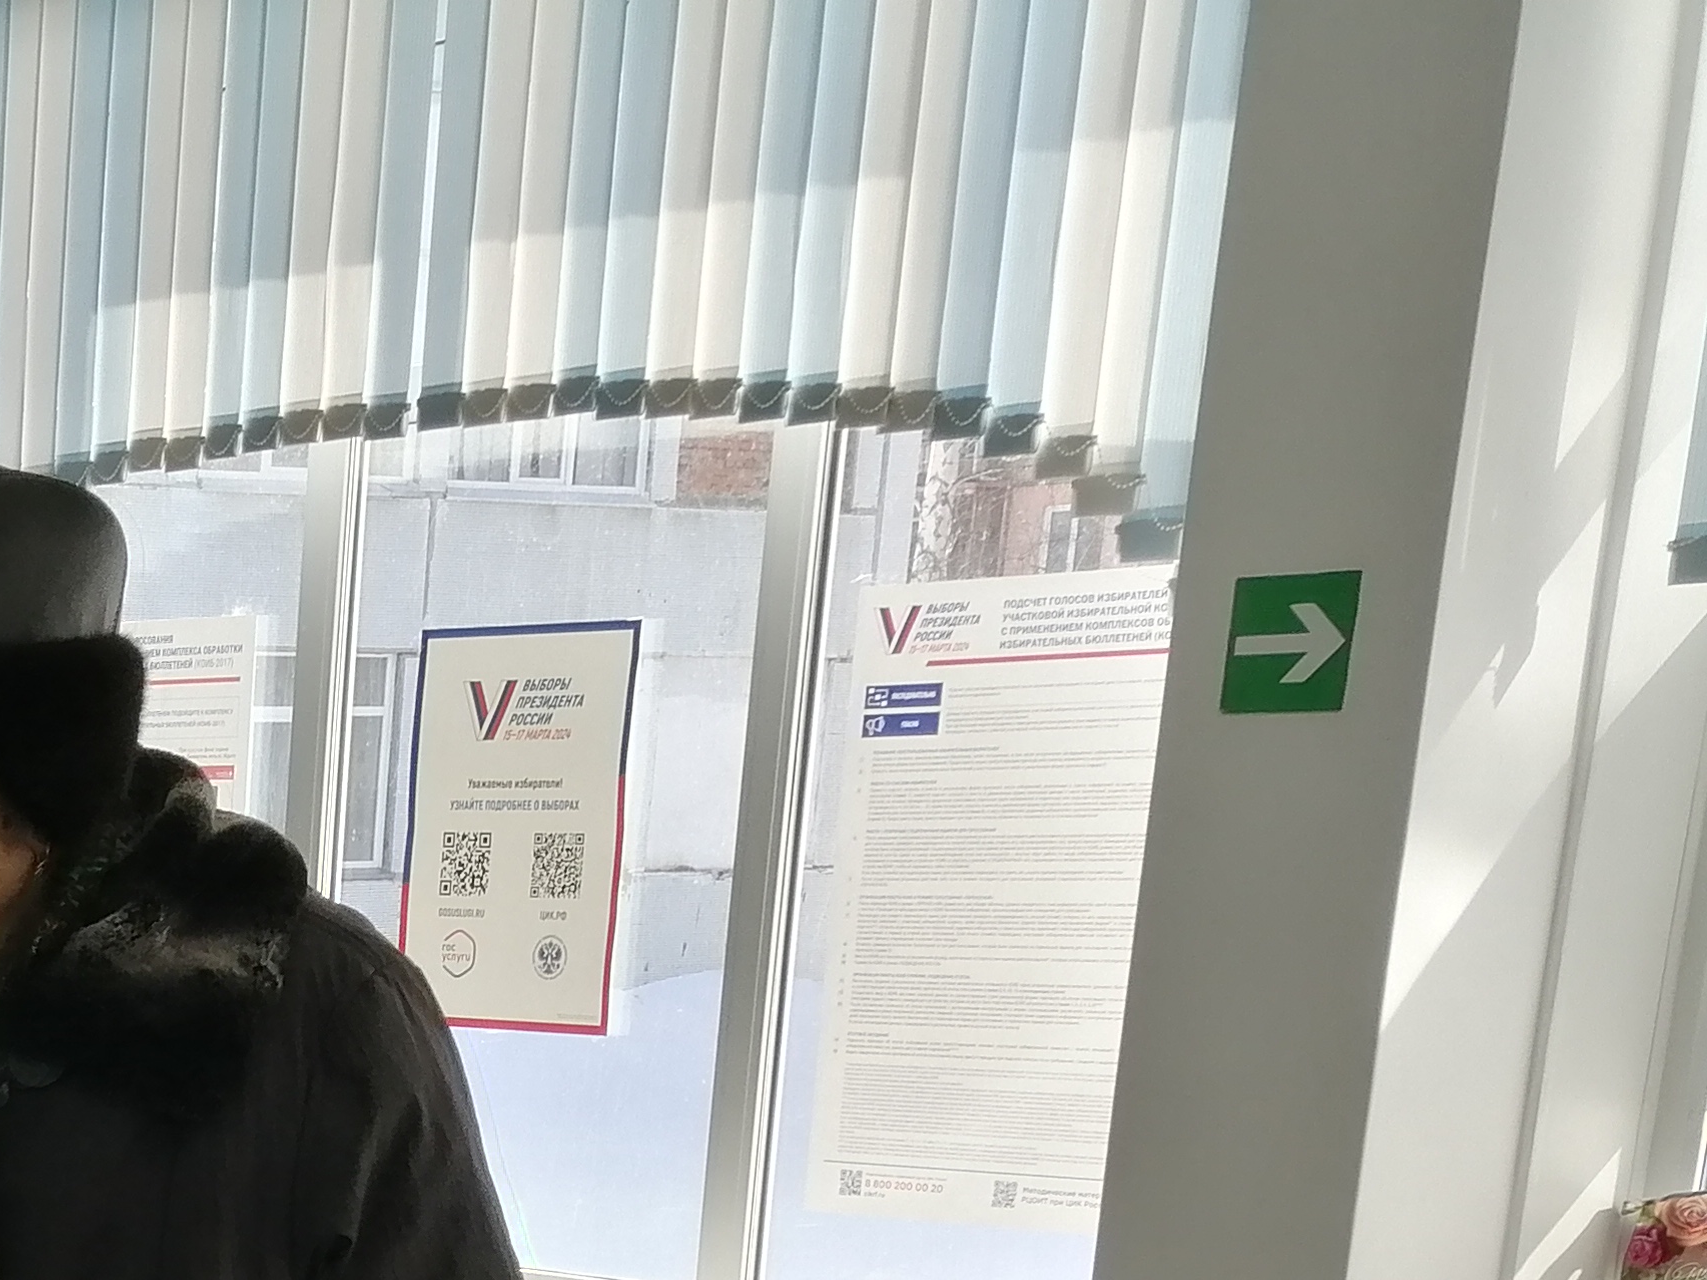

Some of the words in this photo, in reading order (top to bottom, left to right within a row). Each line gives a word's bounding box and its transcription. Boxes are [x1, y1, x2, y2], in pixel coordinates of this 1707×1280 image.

[1003, 597, 1047, 609] ПОДСЧЕТ
[1048, 594, 1095, 606] ГОЛОСОВ
[1096, 588, 1168, 602] ИЗБИРАТЕЛЕЙ
[926, 601, 970, 614] ВЫБОРЫ
[1002, 607, 1064, 622] УЧАСТКОВОЙ
[1066, 603, 1151, 618] ИЗБИРАТЕЛЬНОЙ
[919, 614, 981, 628] ПРЕЗИДЕНТА
[1000, 627, 1007, 635] С
[1009, 622, 1083, 635] ПРИМЕНЕНИЕМ
[1085, 618, 1154, 631] КОМПЛЕКСОВ
[914, 630, 954, 642] РОССИИ
[999, 636, 1082, 649] ИЗБИРАТЕЛЬНЫХ
[1085, 631, 1152, 645] БЮЛЛЕТЕНЕЙ
[162, 647, 202, 657] КОМПЛЕКСА
[203, 644, 243, 655] ОБРАБОТКИ
[522, 677, 572, 692] ВЫБОРЫ
[515, 694, 585, 710] ПРЕЗИДЕНТА
[508, 712, 553, 726] РОССИИ
[525, 729, 551, 740] МАРТА
[551, 728, 571, 740] 2024
[468, 778, 512, 790] Уважаемые
[514, 778, 563, 790] избиратели!
[450, 797, 483, 811] УЗНАЙТЕ
[485, 800, 532, 811] ПОДРОБНЕЕ
[533, 800, 540, 811] О
[541, 800, 580, 811] ВЫБОРАХ
[539, 911, 567, 921] ЦИК.РФ
[442, 943, 456, 951] гос
[865, 1179, 871, 1188] 8
[873, 1180, 892, 1189] 800
[894, 1181, 913, 1191] 200
[915, 1183, 928, 1192] 00
[931, 1184, 943, 1193] 20
